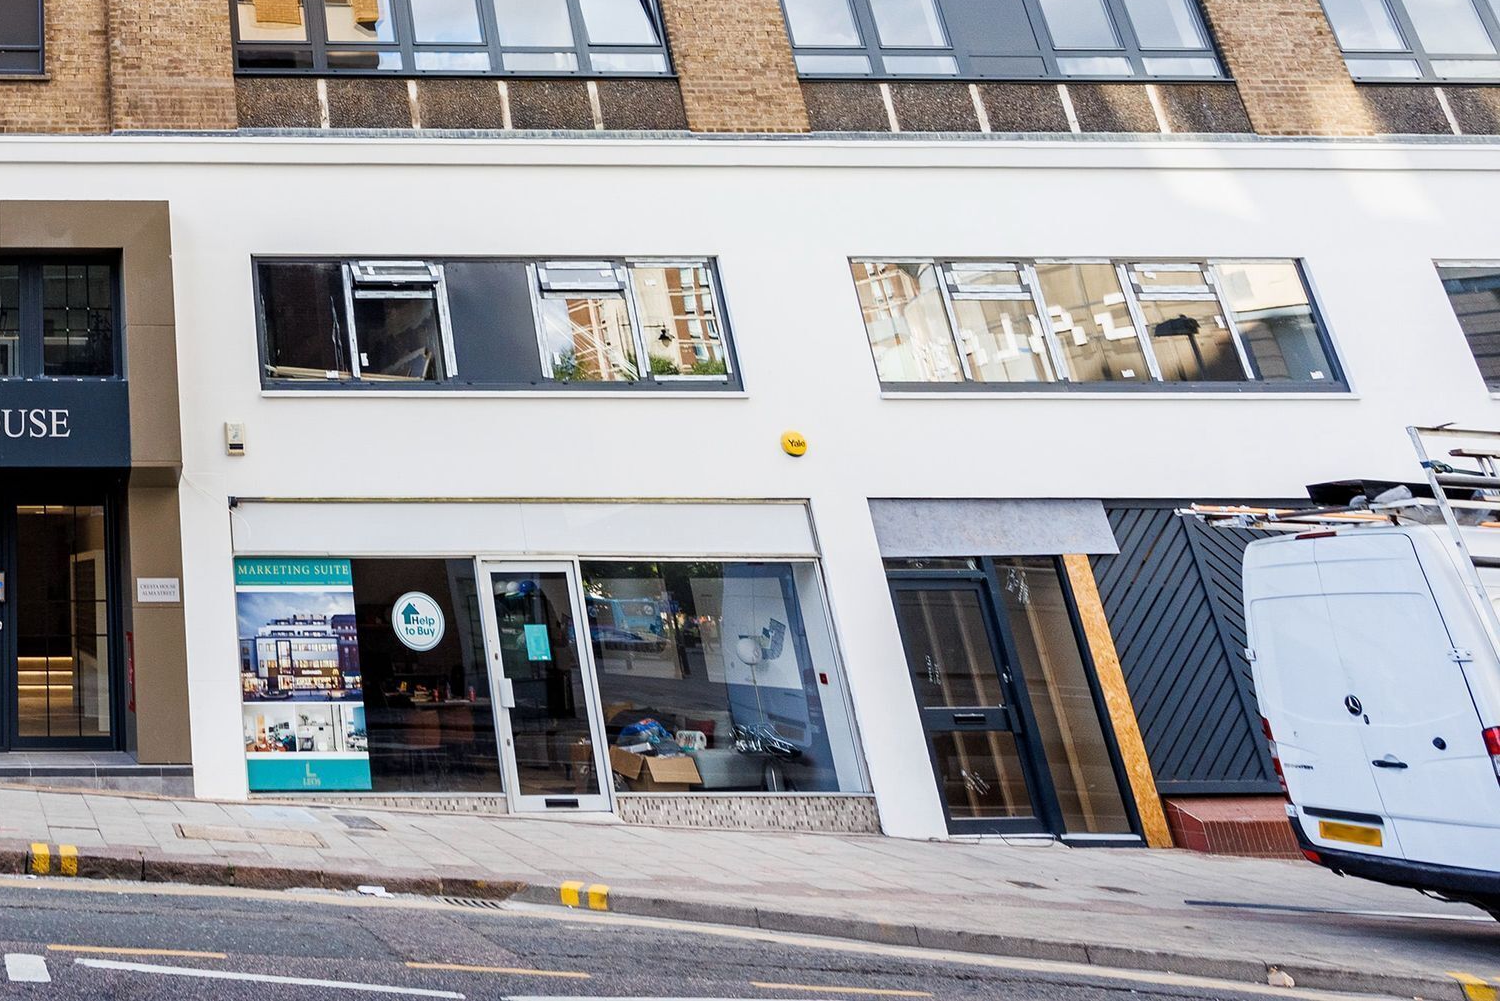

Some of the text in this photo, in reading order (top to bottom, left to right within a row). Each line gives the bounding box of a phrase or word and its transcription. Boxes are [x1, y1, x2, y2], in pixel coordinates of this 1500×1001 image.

[788, 438, 806, 448] Yale
[237, 564, 349, 575] MARKETING SUITE
[411, 615, 435, 627] Help
[405, 626, 436, 638] to Buy
